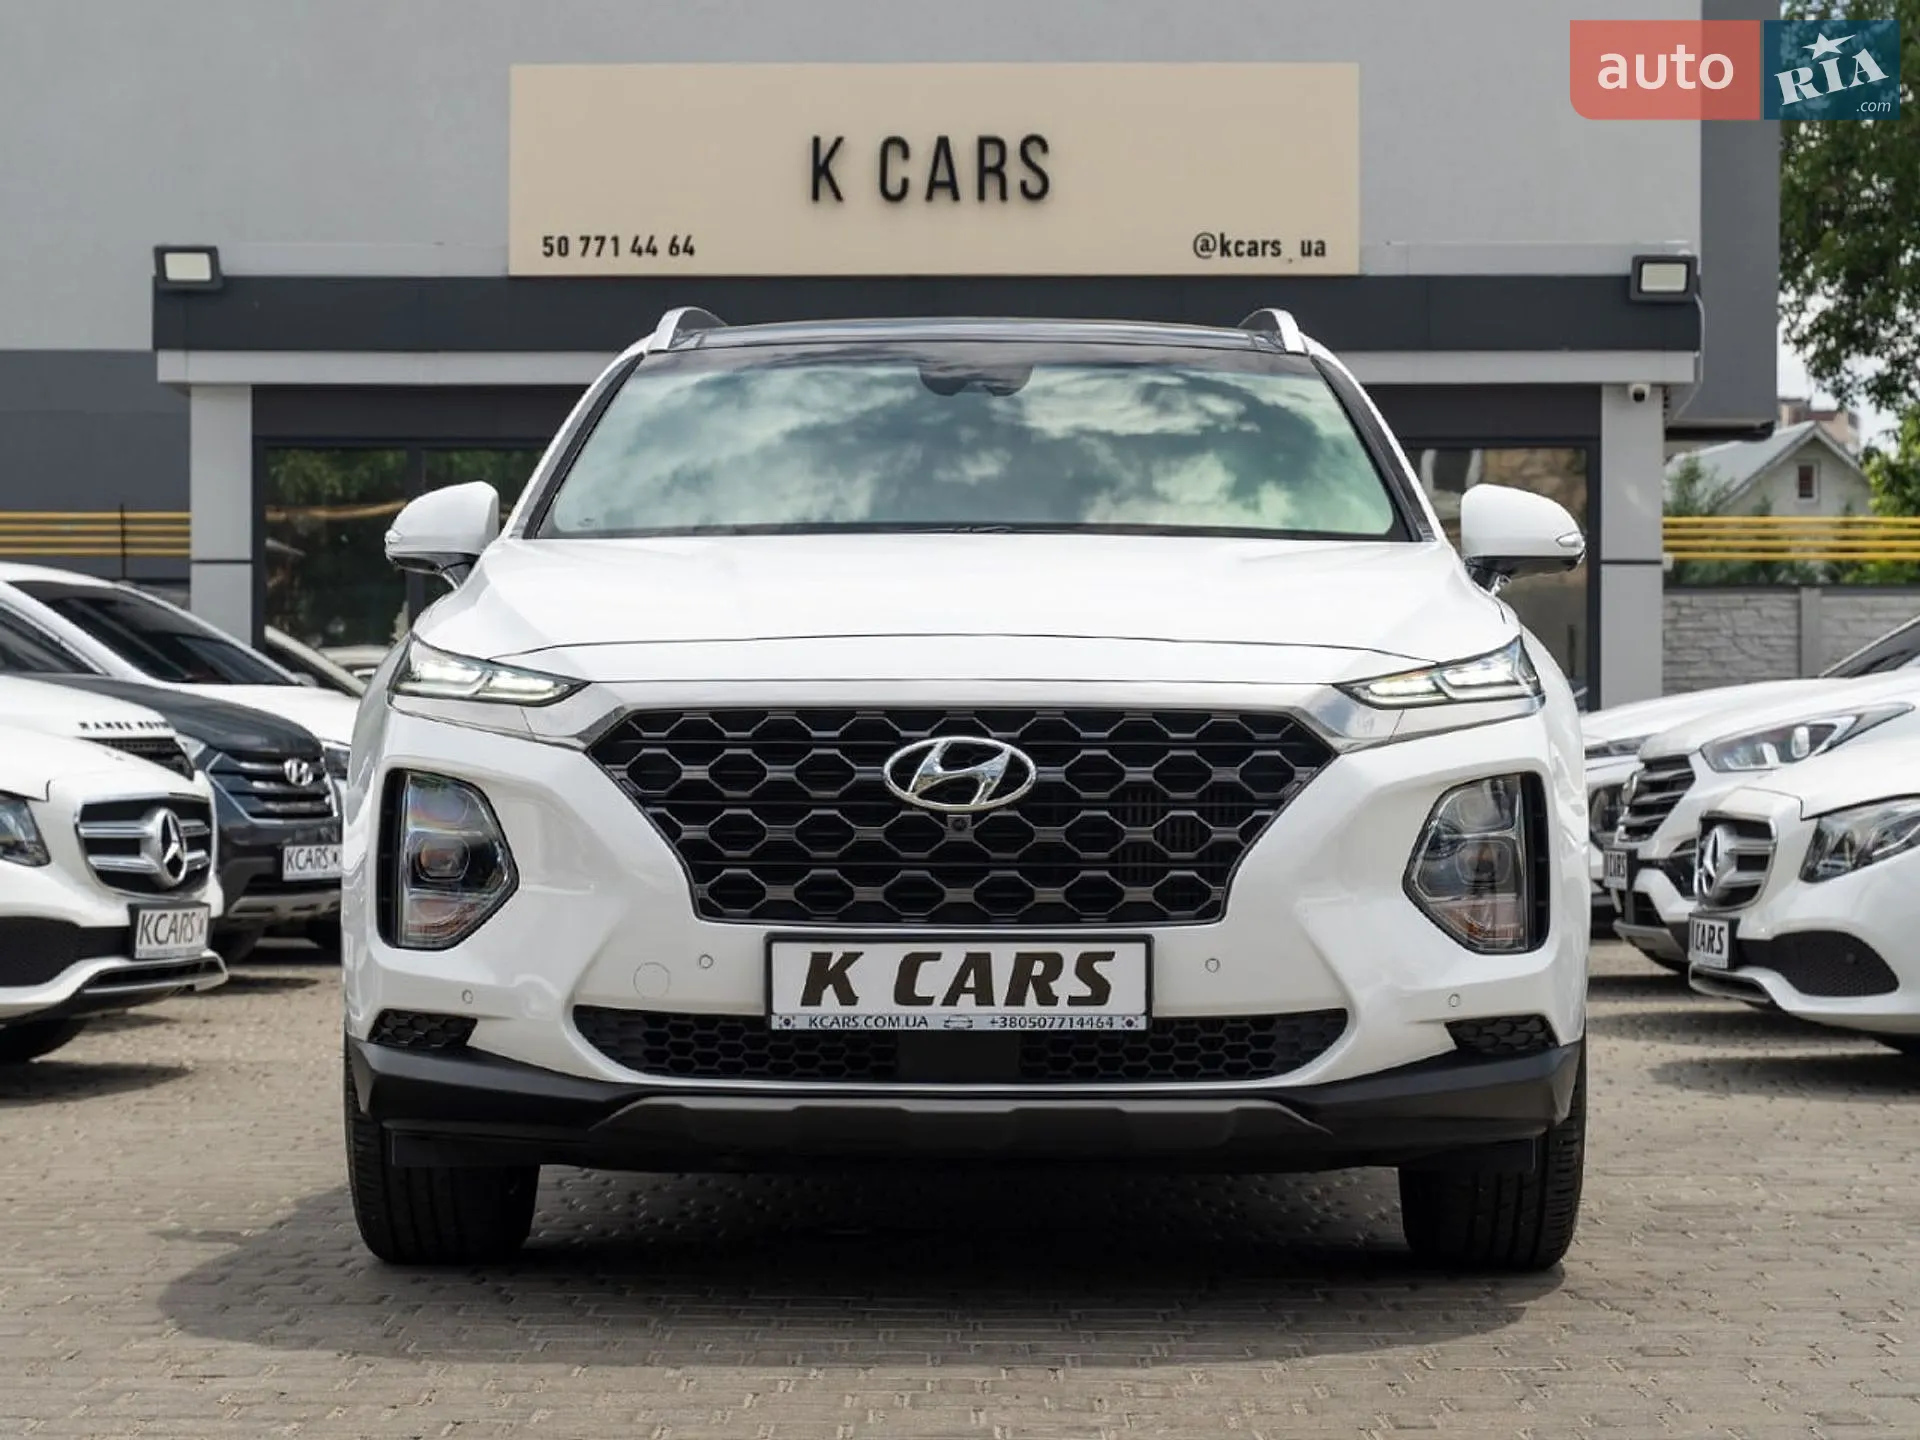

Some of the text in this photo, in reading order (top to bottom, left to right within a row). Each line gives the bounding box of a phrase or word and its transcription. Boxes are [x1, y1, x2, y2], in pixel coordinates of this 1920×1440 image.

[811, 134, 1050, 202] K CARS
[542, 234, 696, 258] 50 771 44 64
[800, 951, 1116, 1007] K CARS
[808, 1015, 1114, 1029] KCARS.COM.UA +380507714464
